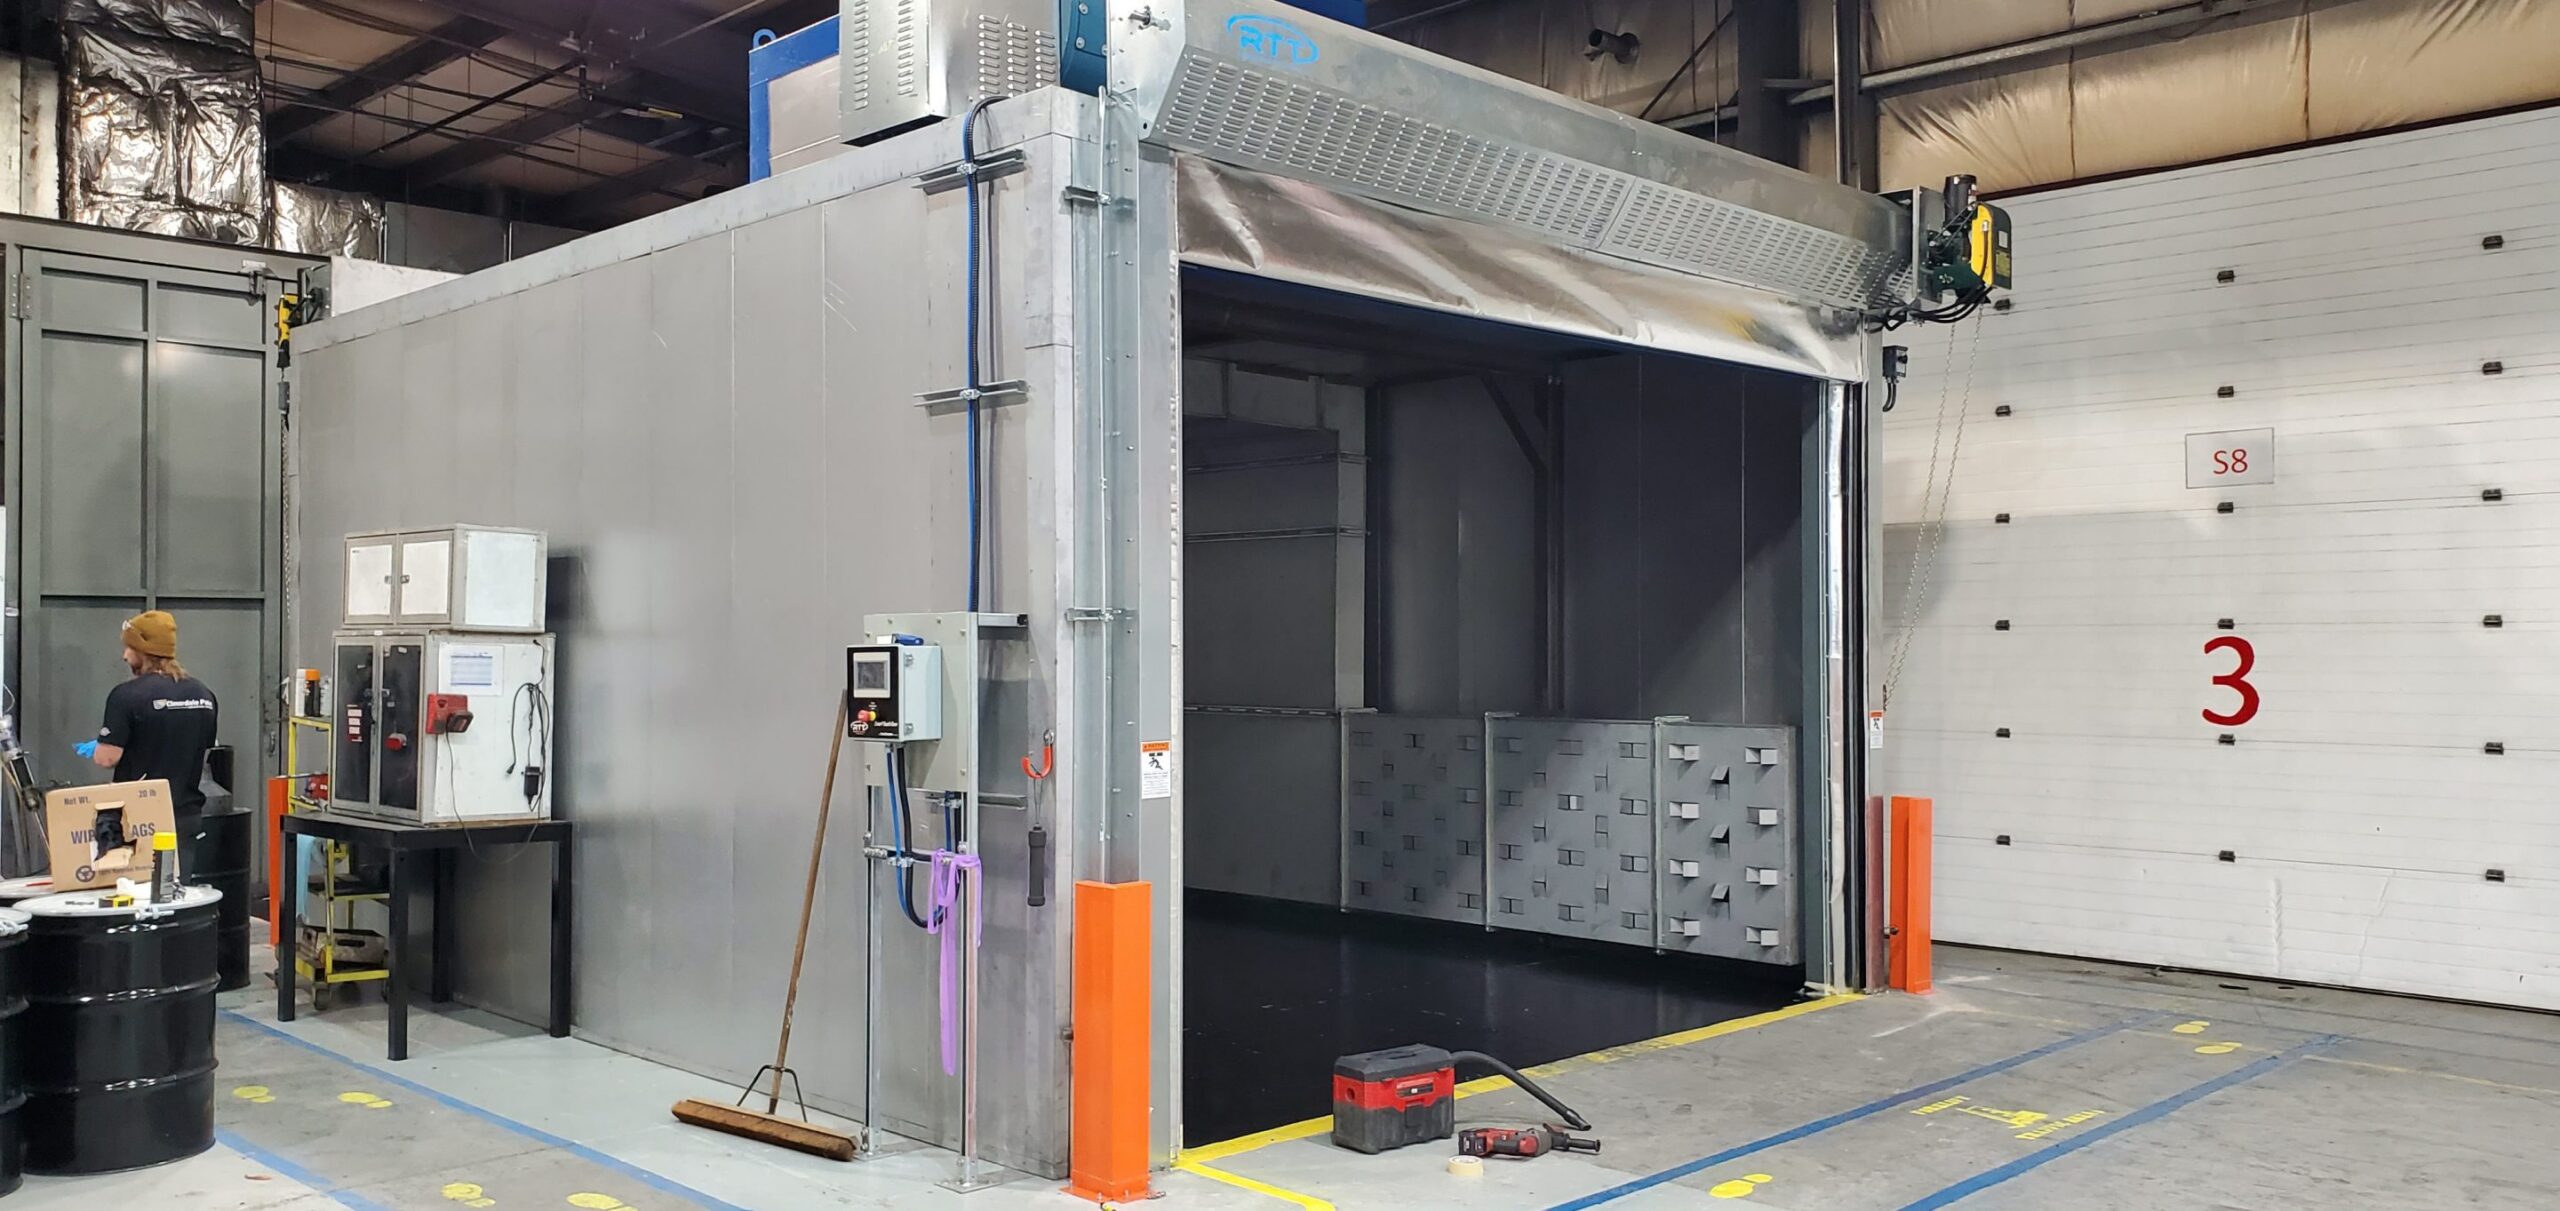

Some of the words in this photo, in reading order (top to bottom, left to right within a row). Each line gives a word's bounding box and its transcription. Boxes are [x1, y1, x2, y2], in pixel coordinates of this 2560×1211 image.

[2213, 448, 2248, 475] S8
[2202, 636, 2260, 726] 3
[131, 822, 156, 838] AGS
